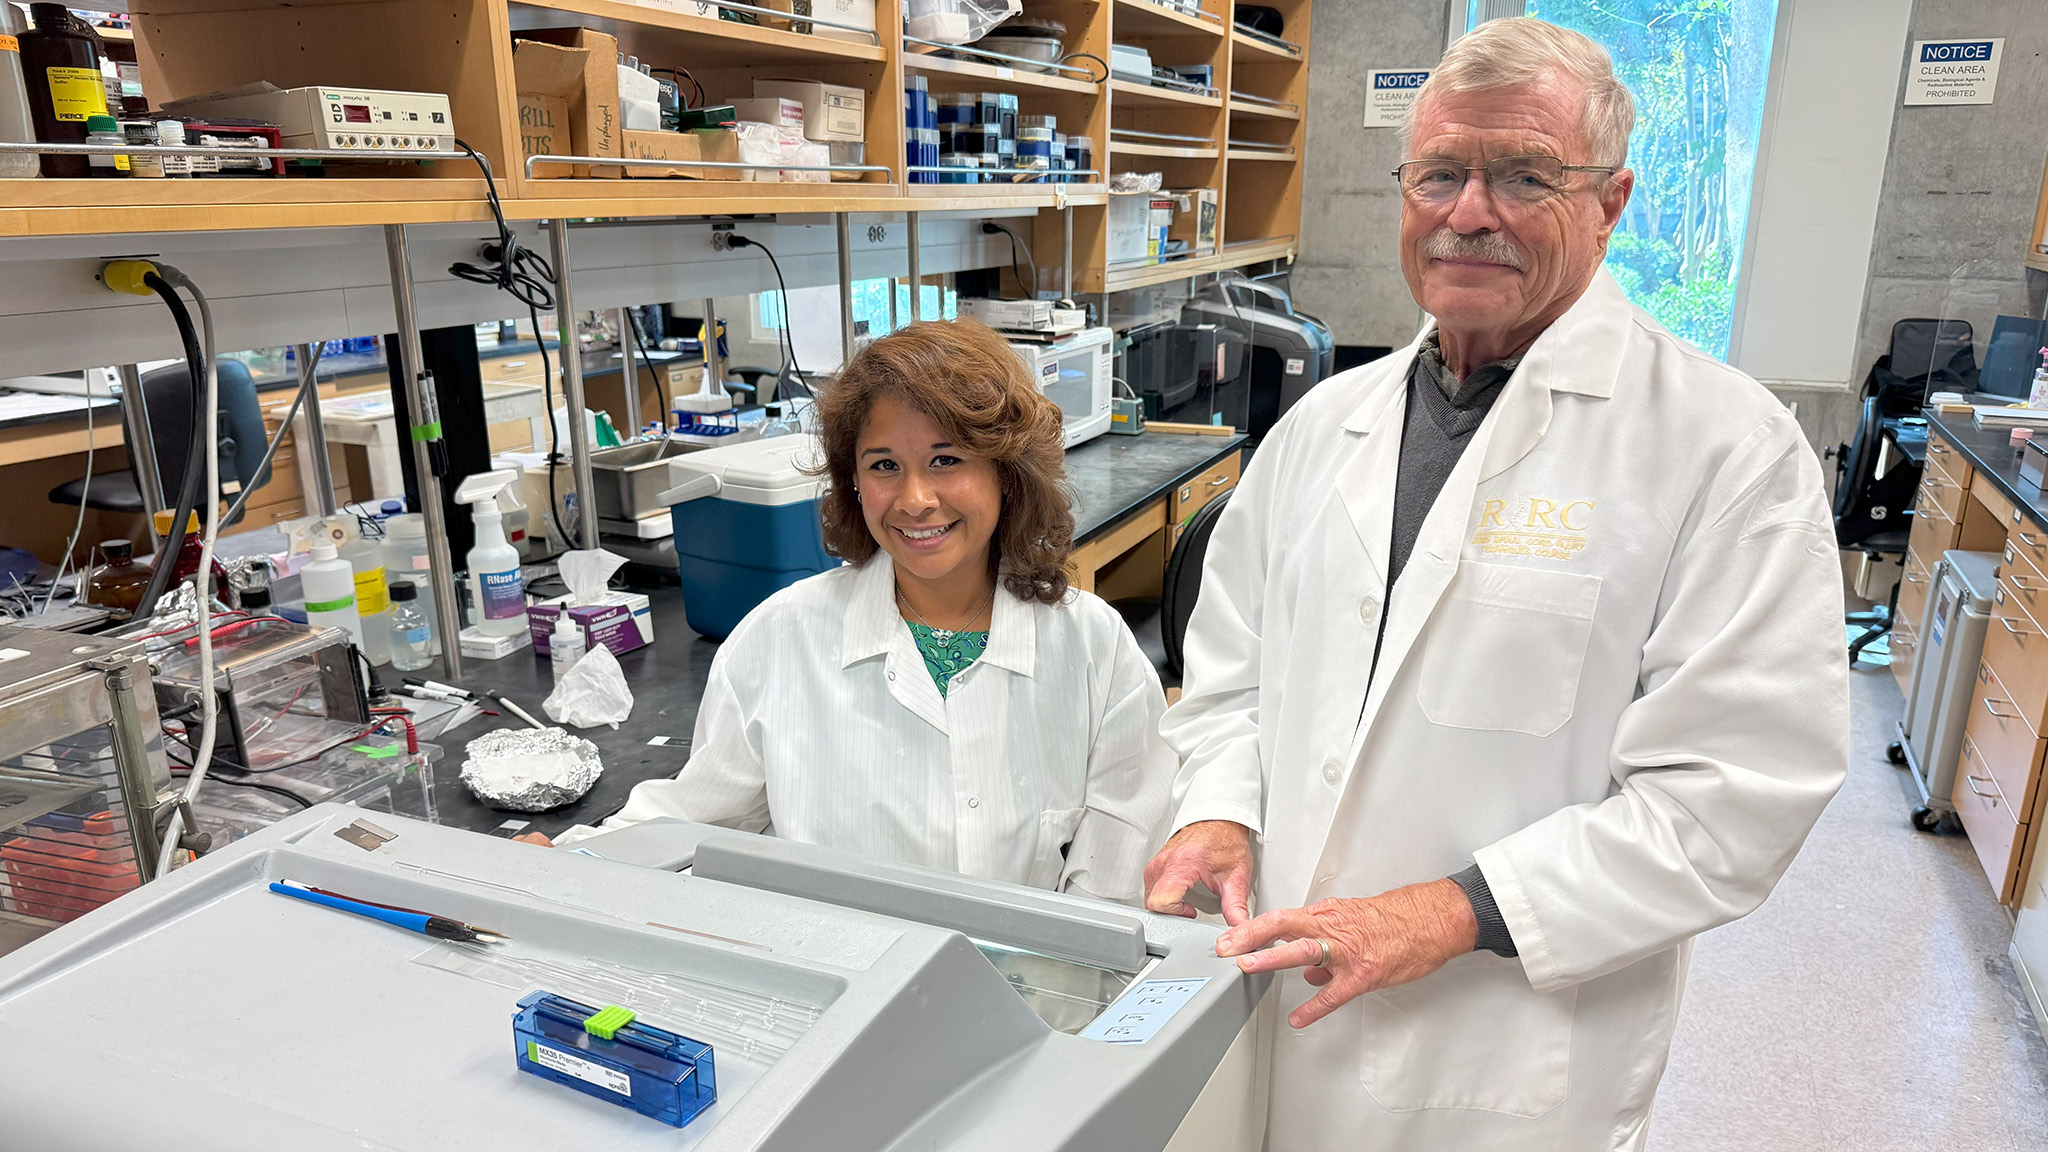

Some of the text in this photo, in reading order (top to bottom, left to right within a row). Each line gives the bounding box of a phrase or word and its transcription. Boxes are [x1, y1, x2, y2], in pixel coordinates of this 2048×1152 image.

[1926, 45, 1987, 59] NOTICE
[1921, 65, 1986, 75] CLEAN AREA
[1378, 75, 1425, 87] NOTICE
[519, 105, 555, 128] RILL
[1493, 536, 1520, 545] SPINAL
[1526, 538, 1552, 547] CORD
[1555, 540, 1586, 551] INJURY
[1481, 545, 1572, 560] TECHNIQUES COURSE
[487, 574, 513, 585] RNase
[591, 614, 606, 623] VWR
[539, 1047, 558, 1059] MX35
